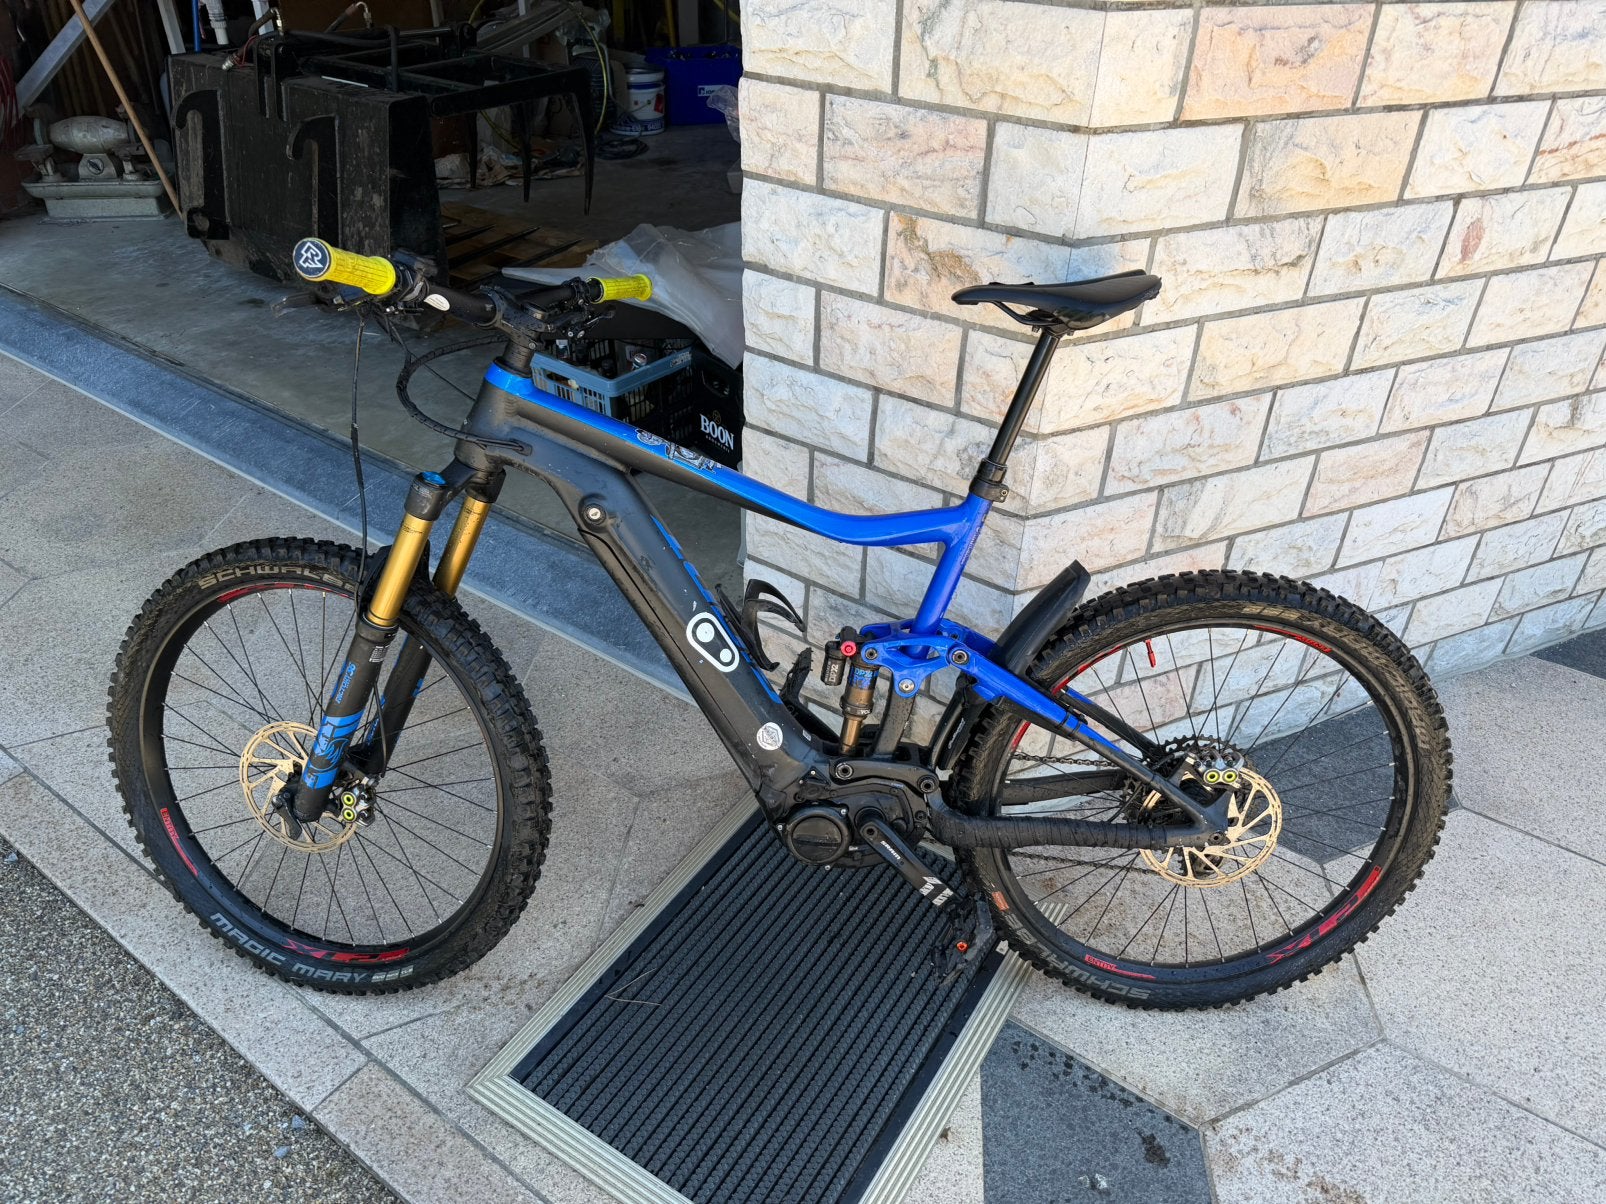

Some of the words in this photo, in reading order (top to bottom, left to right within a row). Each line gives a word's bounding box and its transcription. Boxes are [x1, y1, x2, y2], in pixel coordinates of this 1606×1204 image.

[700, 413, 734, 450] BOON
[828, 663, 839, 682] DPX2
[880, 840, 901, 860] SRAM
[210, 913, 287, 966] MAGIC
[291, 962, 368, 983] MARY
